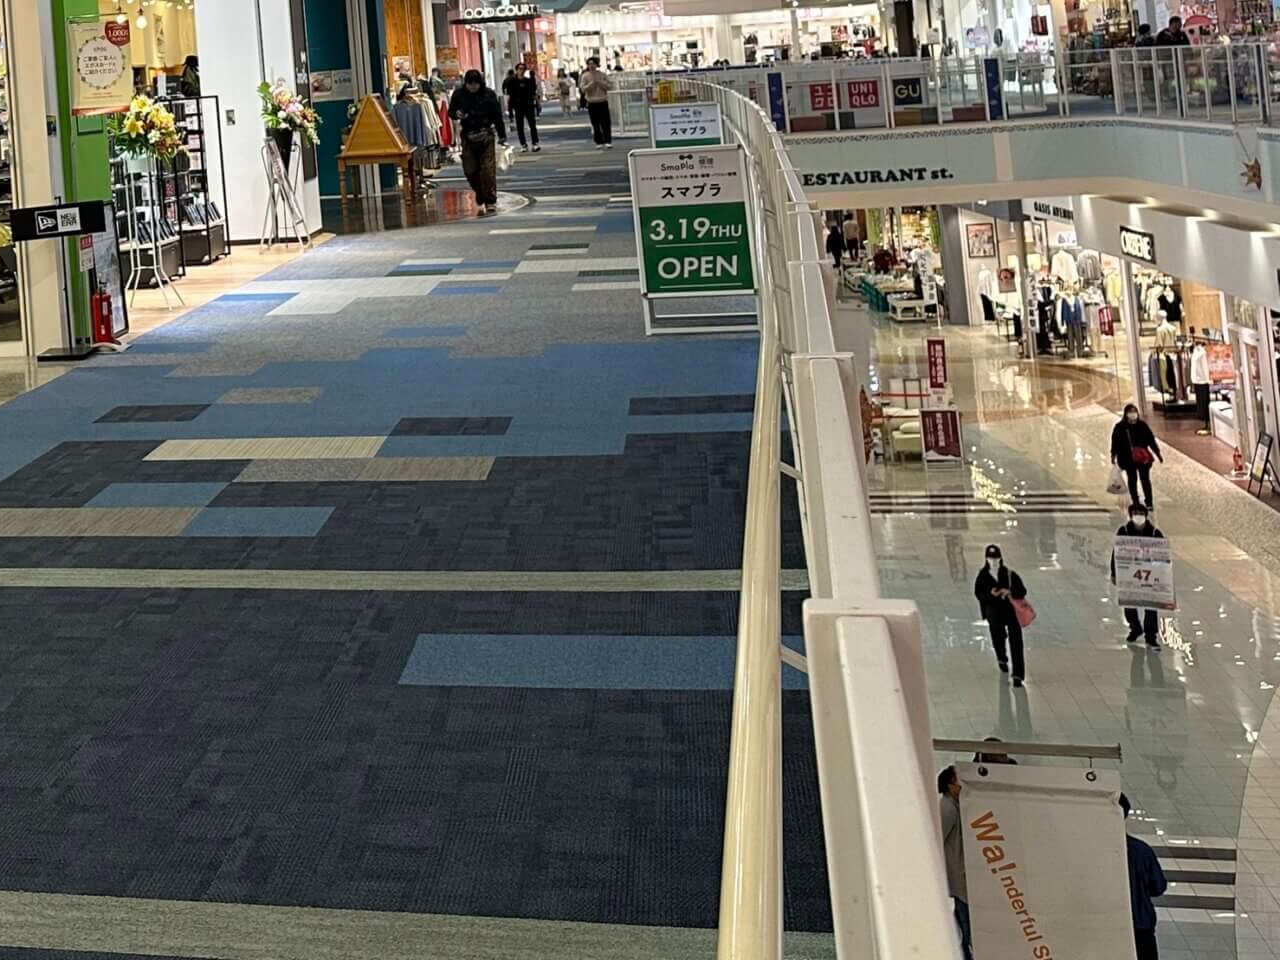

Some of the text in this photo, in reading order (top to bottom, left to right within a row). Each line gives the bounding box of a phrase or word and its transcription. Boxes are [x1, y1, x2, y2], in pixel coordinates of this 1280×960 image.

[496, 4, 535, 17] COURT
[851, 82, 874, 94] UNI
[895, 84, 920, 98] GU
[852, 94, 876, 106] QLO
[661, 161, 694, 172] SmaPla
[802, 168, 954, 187] ESTAURANT st.
[657, 255, 738, 279] OPEN
[970, 810, 1043, 943] Wa!nderful
